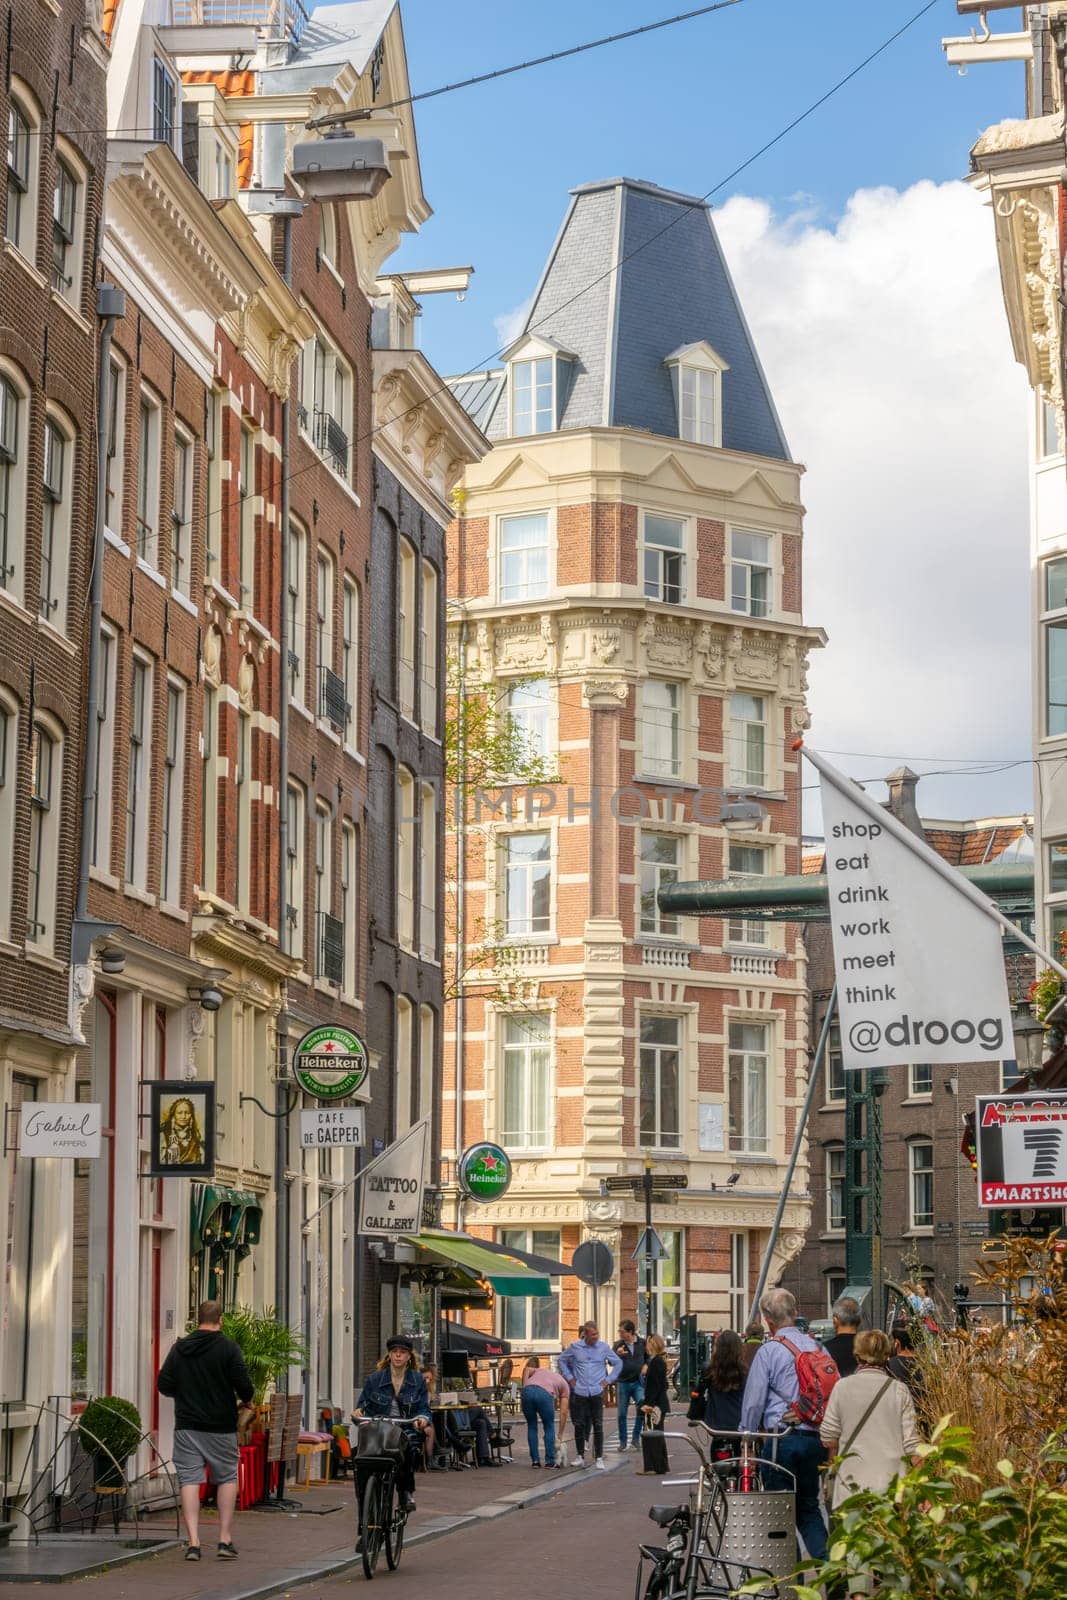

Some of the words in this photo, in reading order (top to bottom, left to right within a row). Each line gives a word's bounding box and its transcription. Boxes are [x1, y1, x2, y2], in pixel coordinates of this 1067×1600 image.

[832, 822, 882, 840] shop
[835, 853, 870, 871] eat
[838, 885, 889, 904] drink
[840, 918, 891, 937] work
[842, 951, 896, 970] meet
[846, 984, 897, 1004] think
[849, 1014, 1004, 1053] @droog
[301, 1056, 360, 1069] Heineken
[26, 1110, 97, 1137] Gabriel
[318, 1113, 344, 1124] CAFE
[304, 1133, 314, 1144] DE
[317, 1127, 360, 1143] GAEPER
[368, 1176, 418, 1194] TATTOO
[388, 1200, 396, 1211] &
[365, 1216, 415, 1230] GALLERY
